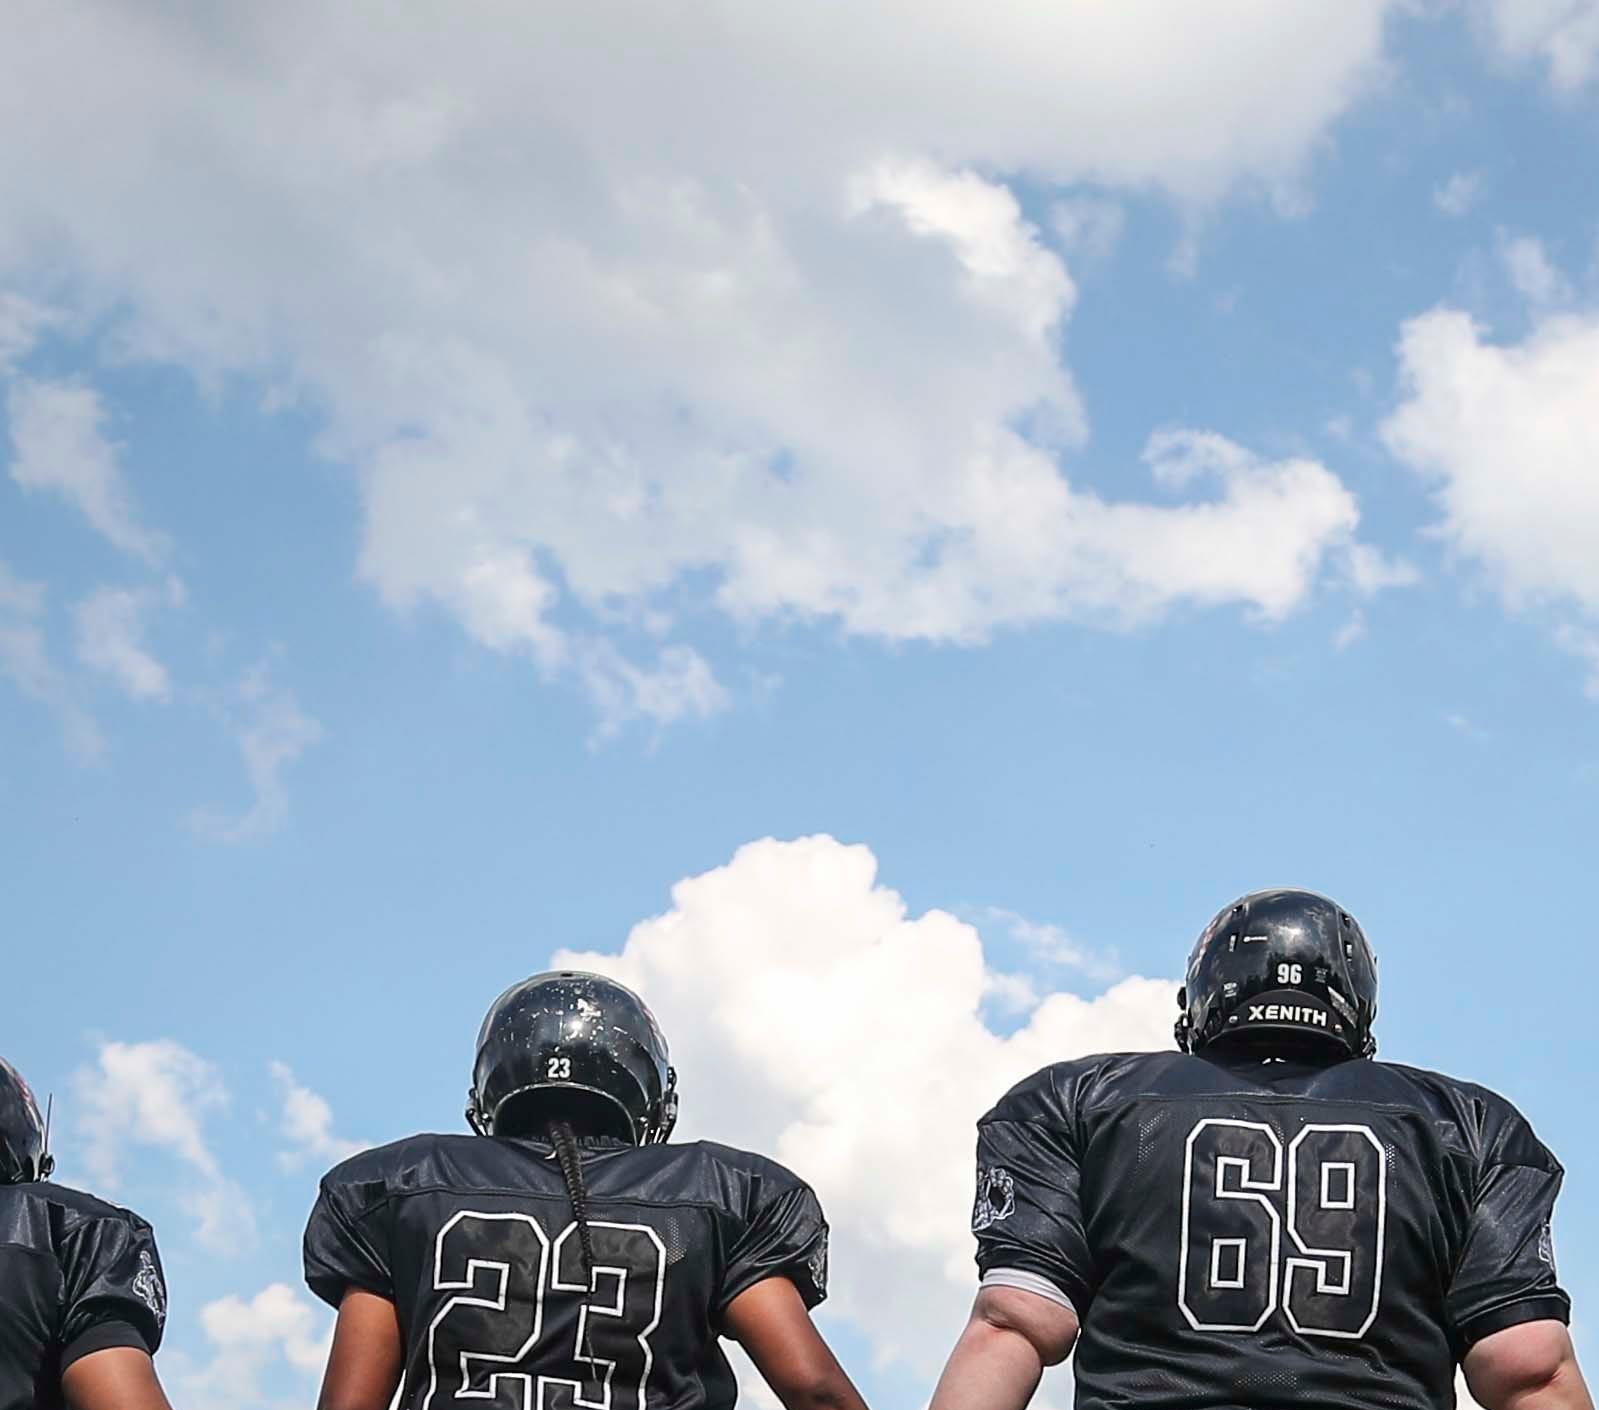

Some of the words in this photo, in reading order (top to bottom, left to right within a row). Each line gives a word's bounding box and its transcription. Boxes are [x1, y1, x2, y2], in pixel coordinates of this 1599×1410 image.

[1277, 963, 1302, 985] 96
[1248, 1004, 1327, 1027] XENITH
[547, 1057, 571, 1078] 23
[1178, 1118, 1388, 1340] 69
